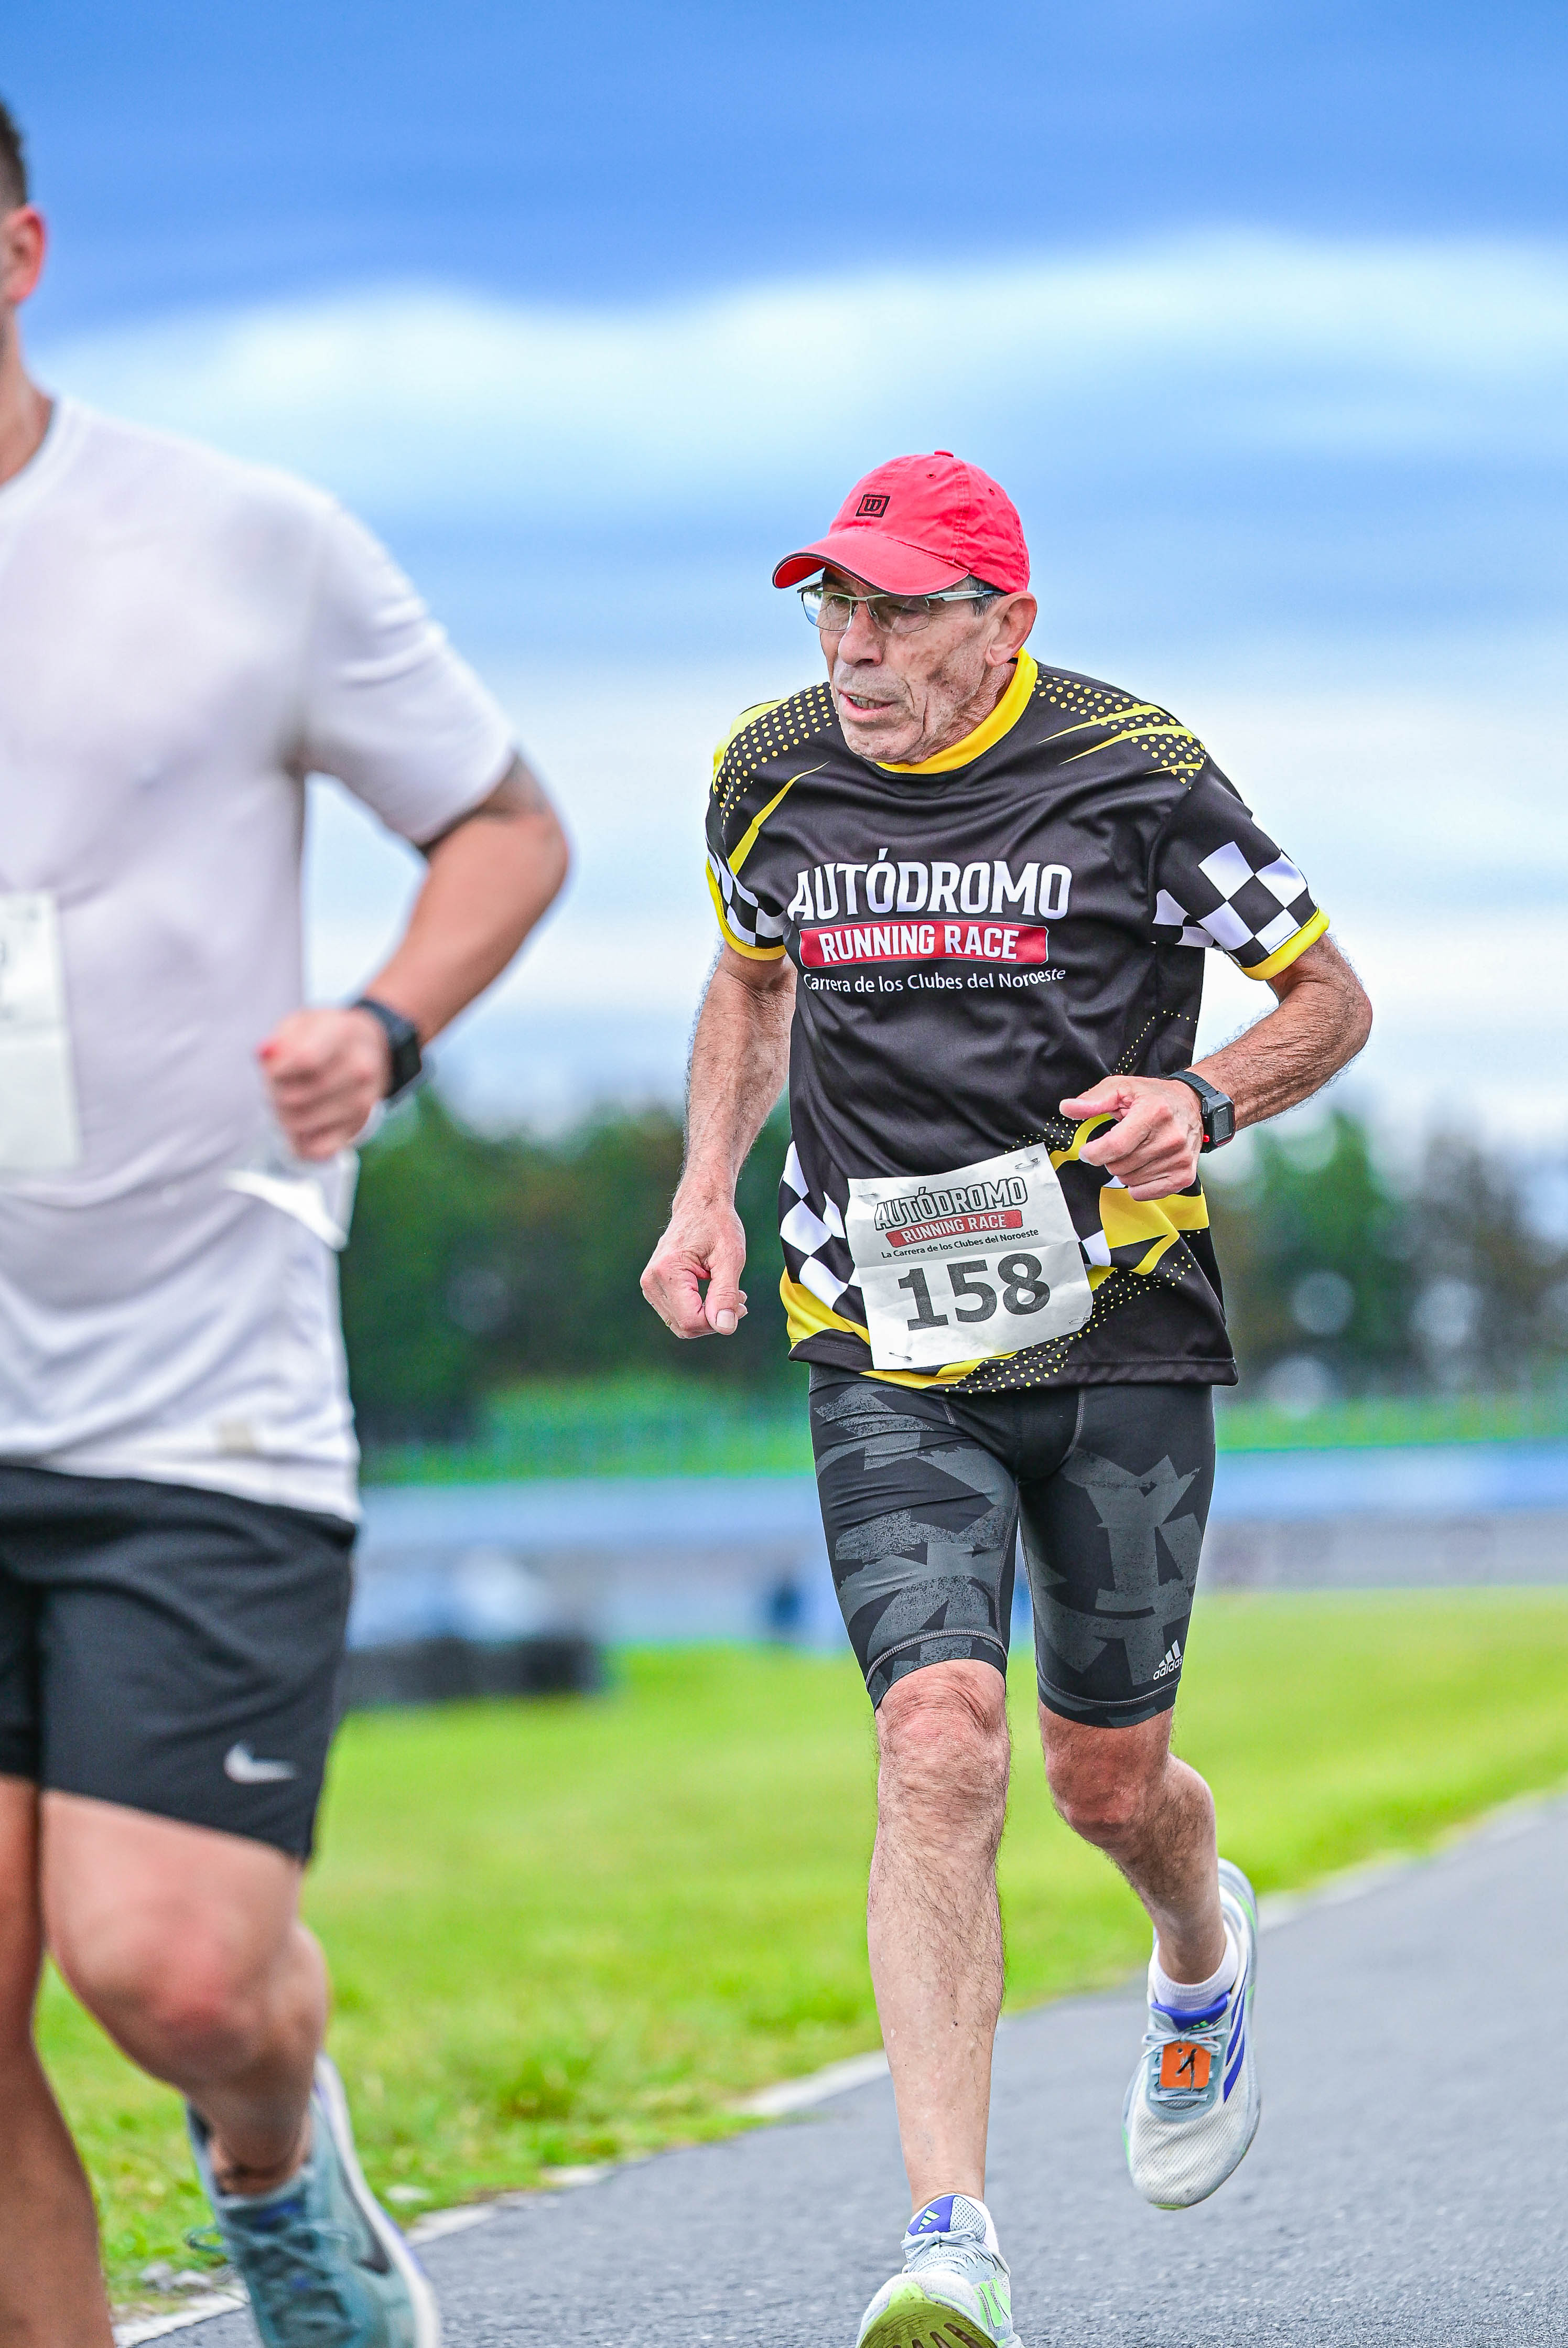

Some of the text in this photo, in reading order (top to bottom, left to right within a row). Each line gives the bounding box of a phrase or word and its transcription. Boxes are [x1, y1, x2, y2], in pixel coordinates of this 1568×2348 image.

[787, 848, 1073, 921] AUTÓDROMO
[818, 924, 1020, 963] RUNNING RACE
[803, 968, 1066, 993] Carrera de los Clubes del Noroeste
[874, 1177, 1028, 1231] AUTÓDROMO
[893, 1247, 926, 1257] Carrera
[954, 1238, 983, 1248] Clubes
[985, 1235, 999, 1244] del
[999, 1229, 1039, 1242] Noroeste
[900, 1214, 1007, 1243] RUNNING RACE
[897, 1253, 1051, 1331] 158
[1153, 1655, 1183, 1680] adidas
